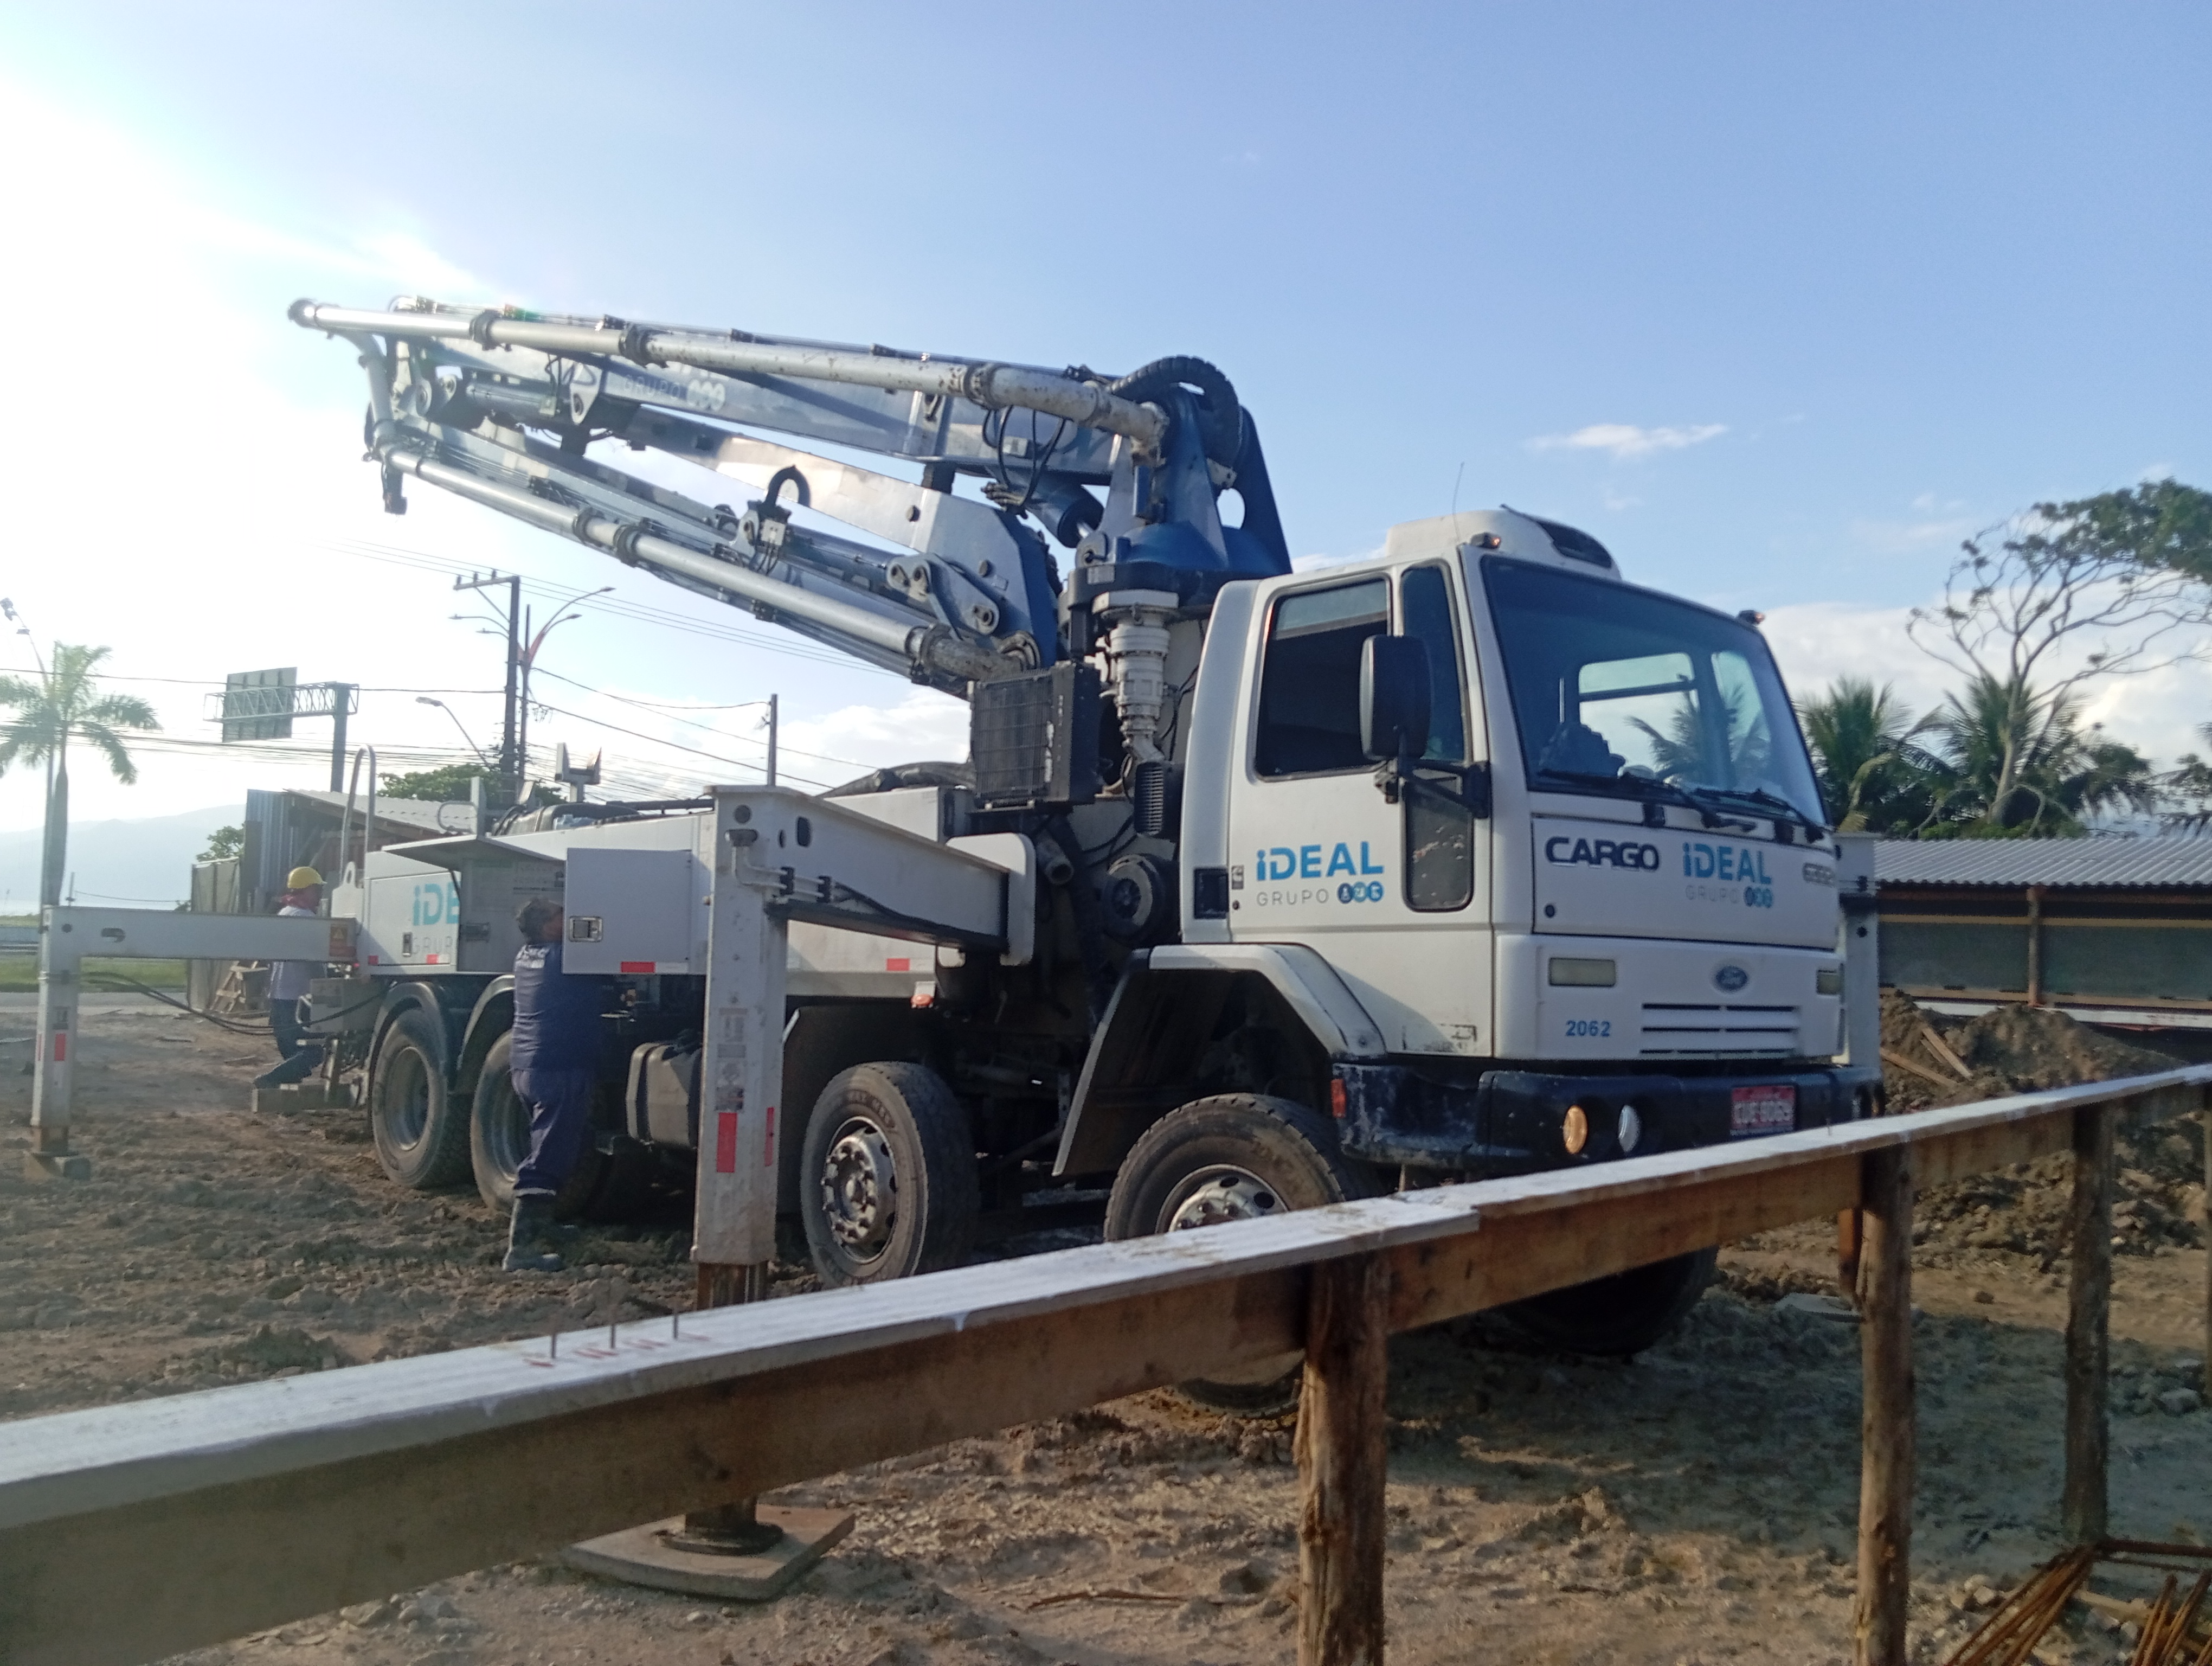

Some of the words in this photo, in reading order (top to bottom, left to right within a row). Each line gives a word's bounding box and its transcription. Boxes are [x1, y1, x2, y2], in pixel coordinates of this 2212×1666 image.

[1545, 836, 1660, 871] CARGO
[413, 880, 461, 926] iDE
[1256, 888, 1329, 906] GRUPO
[1685, 885, 1740, 904] GRUPO
[1565, 1020, 1611, 1037] 2062
